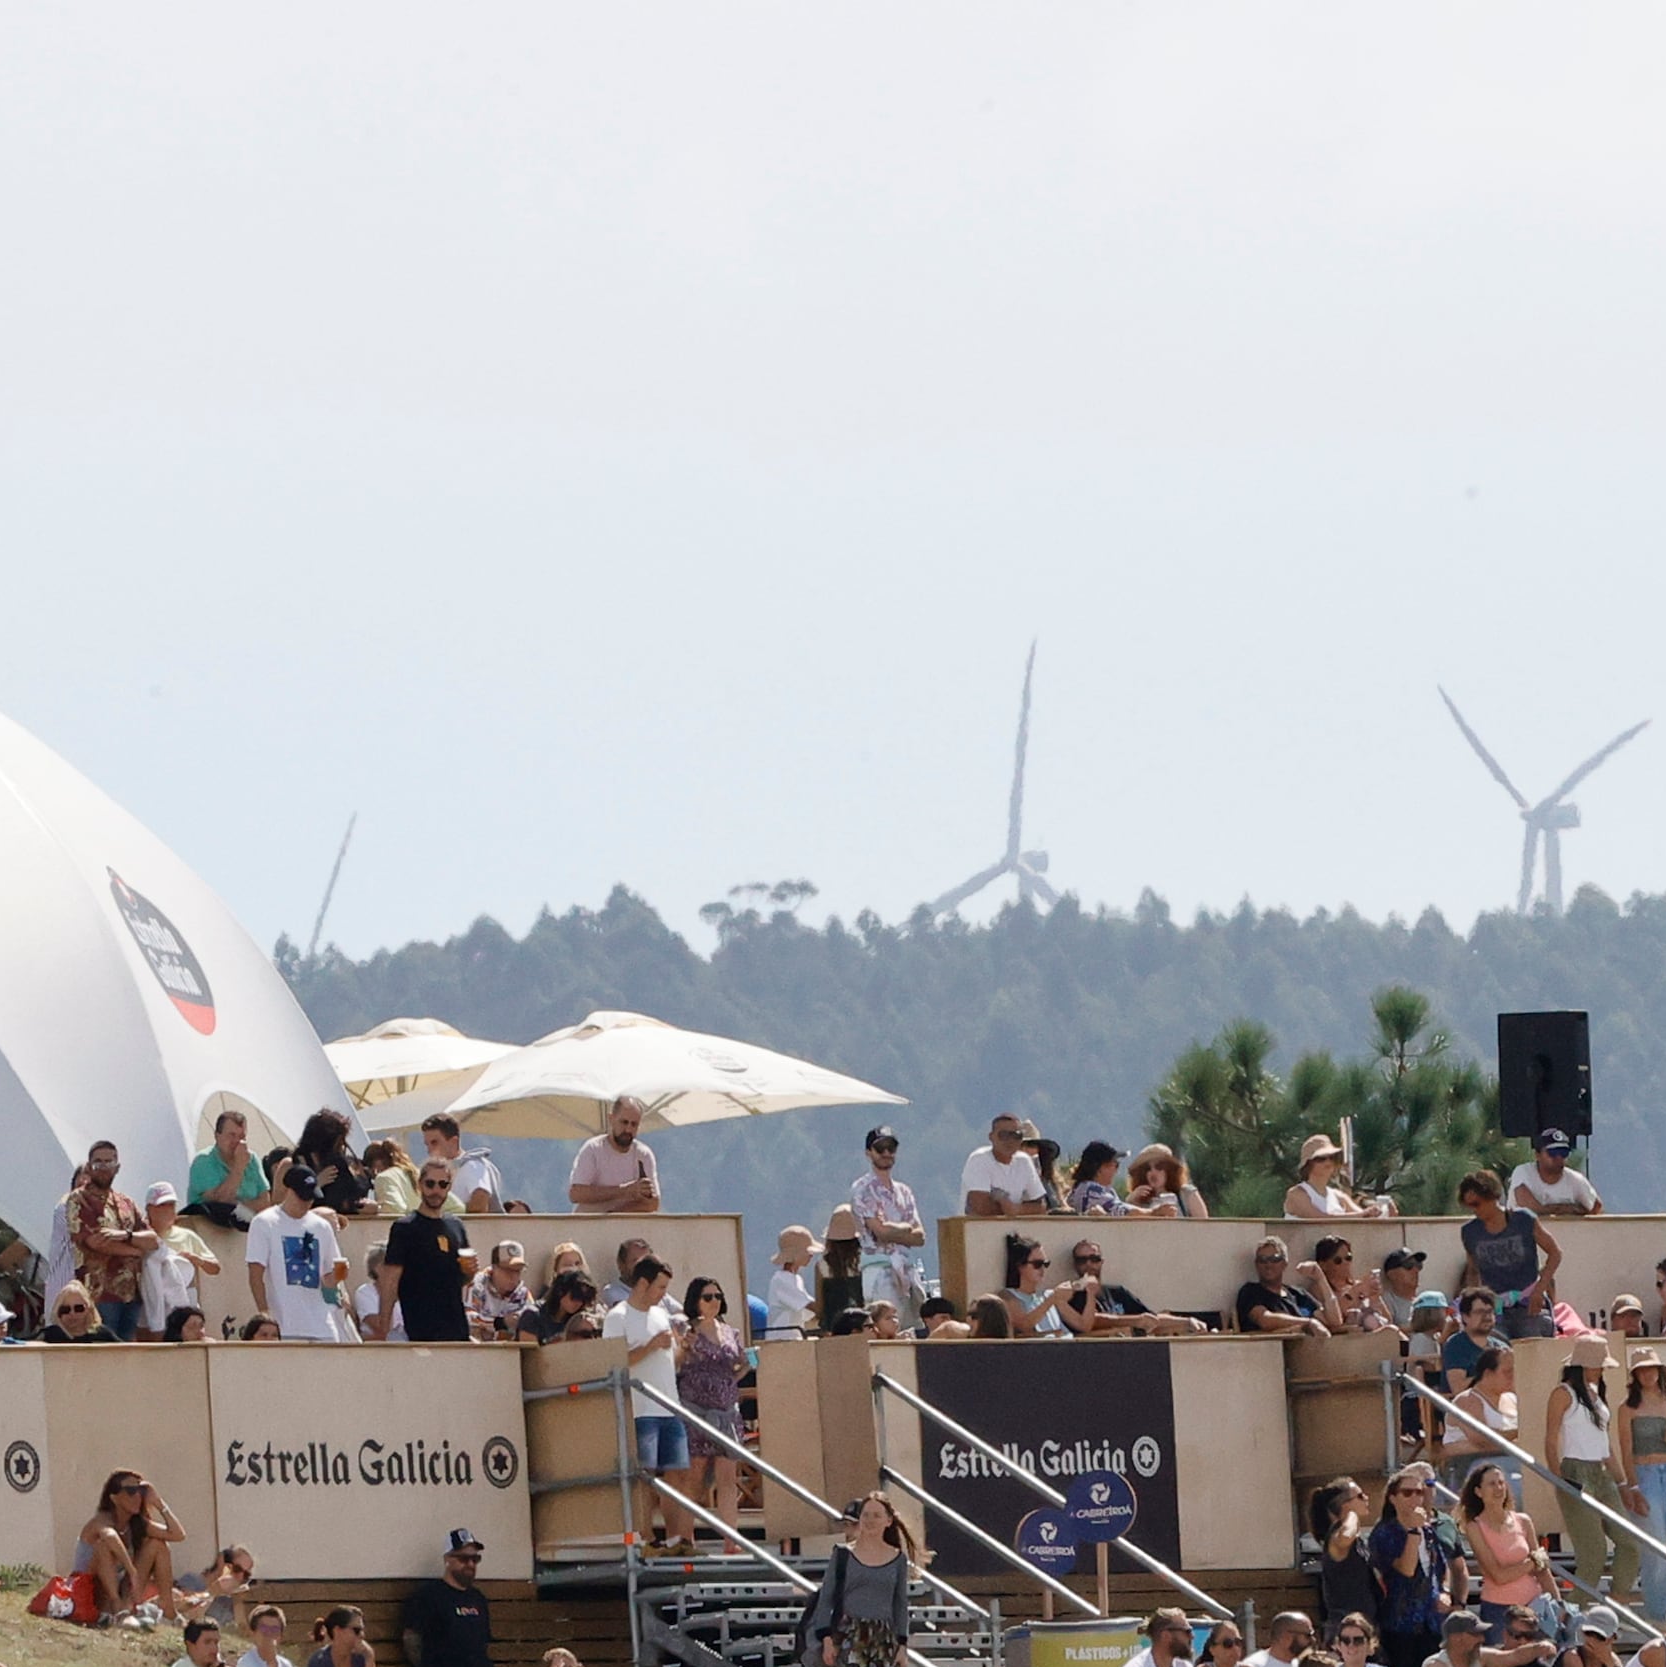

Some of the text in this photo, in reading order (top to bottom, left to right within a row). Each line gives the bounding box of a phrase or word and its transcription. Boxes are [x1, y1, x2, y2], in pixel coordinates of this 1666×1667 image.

[225, 1440, 473, 1486] Estrella Galicia
[1040, 1439, 1127, 1477] Galicia
